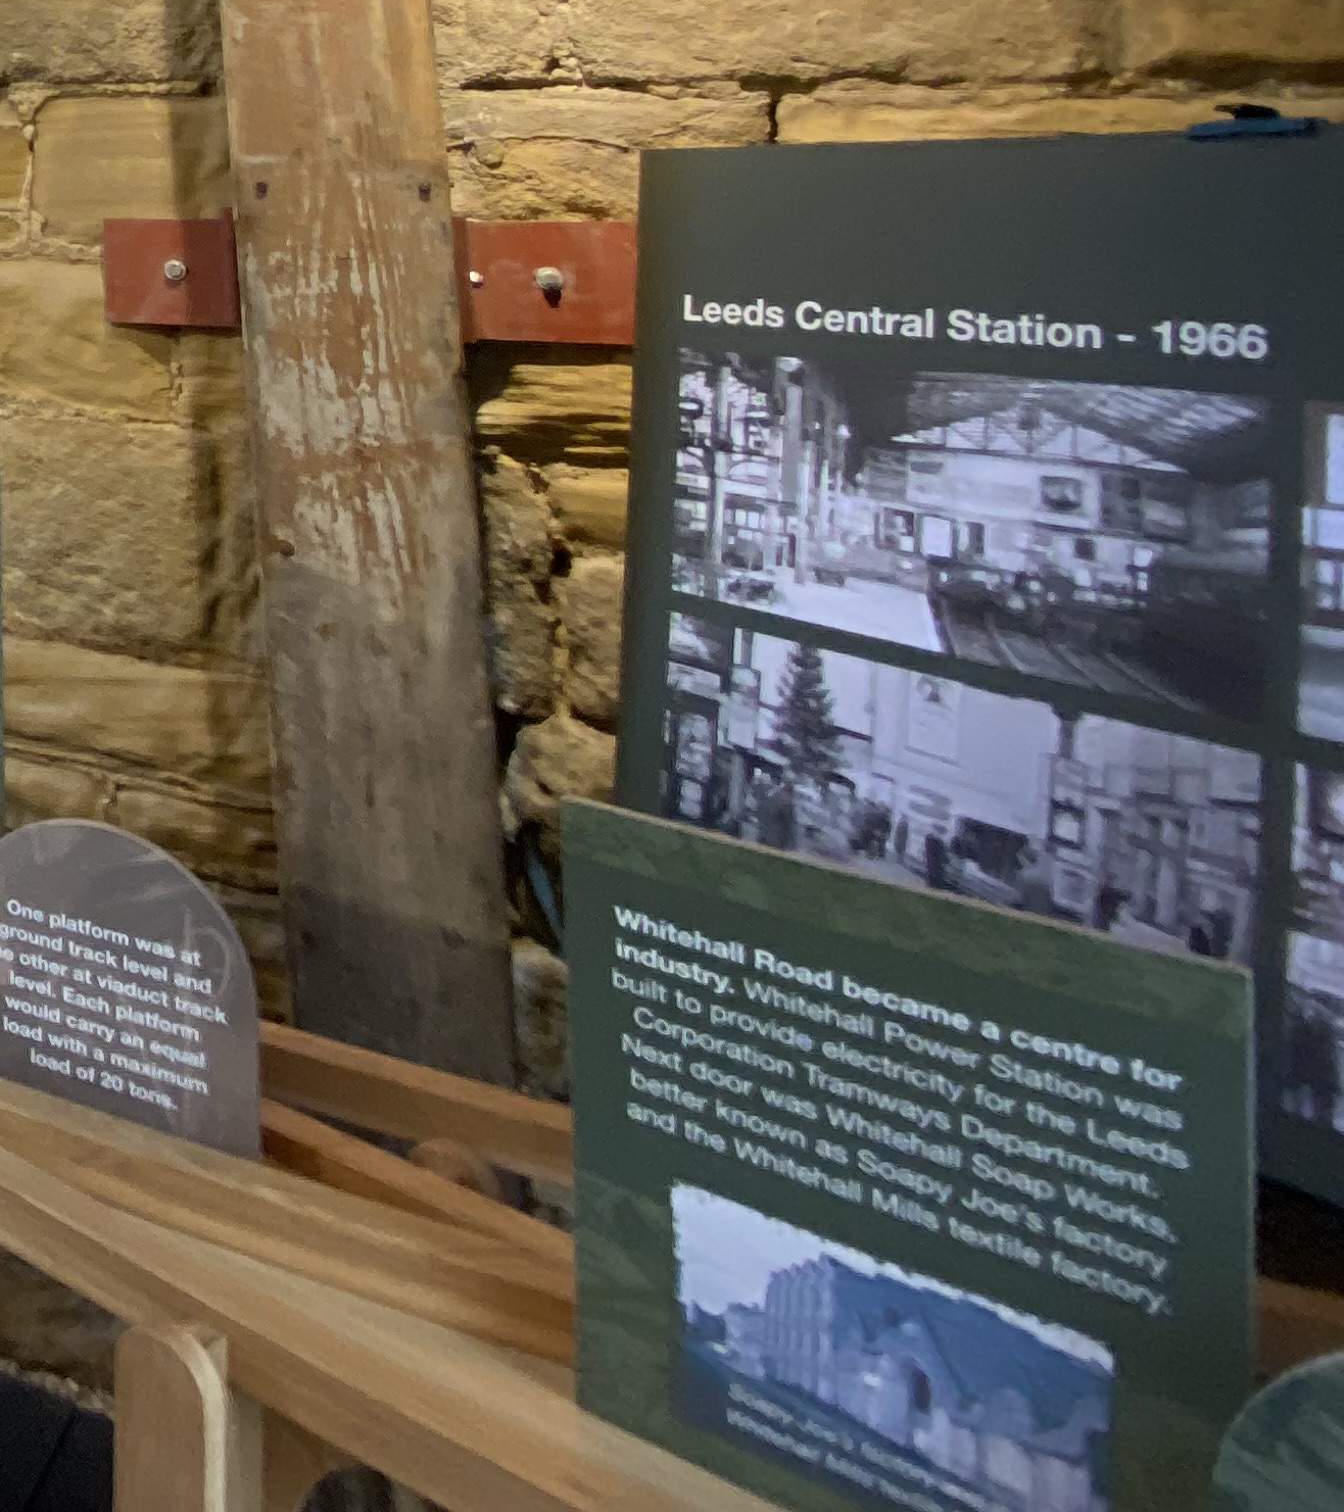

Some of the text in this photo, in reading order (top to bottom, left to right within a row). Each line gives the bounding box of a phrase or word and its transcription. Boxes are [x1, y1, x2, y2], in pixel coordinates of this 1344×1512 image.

[682, 294, 784, 330] Leeds
[794, 300, 935, 341] Central
[947, 309, 1103, 351] Station
[1151, 320, 1268, 360] 1966
[6, 899, 202, 968] One platform was at
[68, 939, 117, 968] track
[122, 954, 168, 983] level
[174, 970, 212, 995] and
[9, 970, 200, 1042] level. Each platform
[19, 951, 68, 978] other
[73, 964, 92, 986] at
[96, 974, 169, 1008] viaduct
[174, 995, 229, 1026] track
[613, 904, 1183, 1091] Whitehall Road became a centre for
[2, 1016, 210, 1096] load with a maximum
[4, 994, 207, 1070] would carry an equal
[611, 966, 1190, 1170] built to provide electricity for the Leeds
[615, 937, 1184, 1130] industry. Whitehall Power Station was
[30, 1048, 179, 1112] load of 20 tons.
[621, 1033, 683, 1074] Next
[689, 1061, 753, 1096] door
[761, 1086, 818, 1120] was
[825, 1103, 961, 1169] Whitehall
[971, 1152, 1055, 1201] Soap
[633, 1006, 1160, 1199] Corporation Tramways Department.
[626, 1101, 676, 1135] and
[684, 1120, 727, 1153] the
[734, 1137, 862, 1203] Whitehall
[872, 1187, 940, 1232] Mills
[949, 1217, 1042, 1268] textile
[630, 1066, 1167, 1279] better known as Soapy Joe's factory
